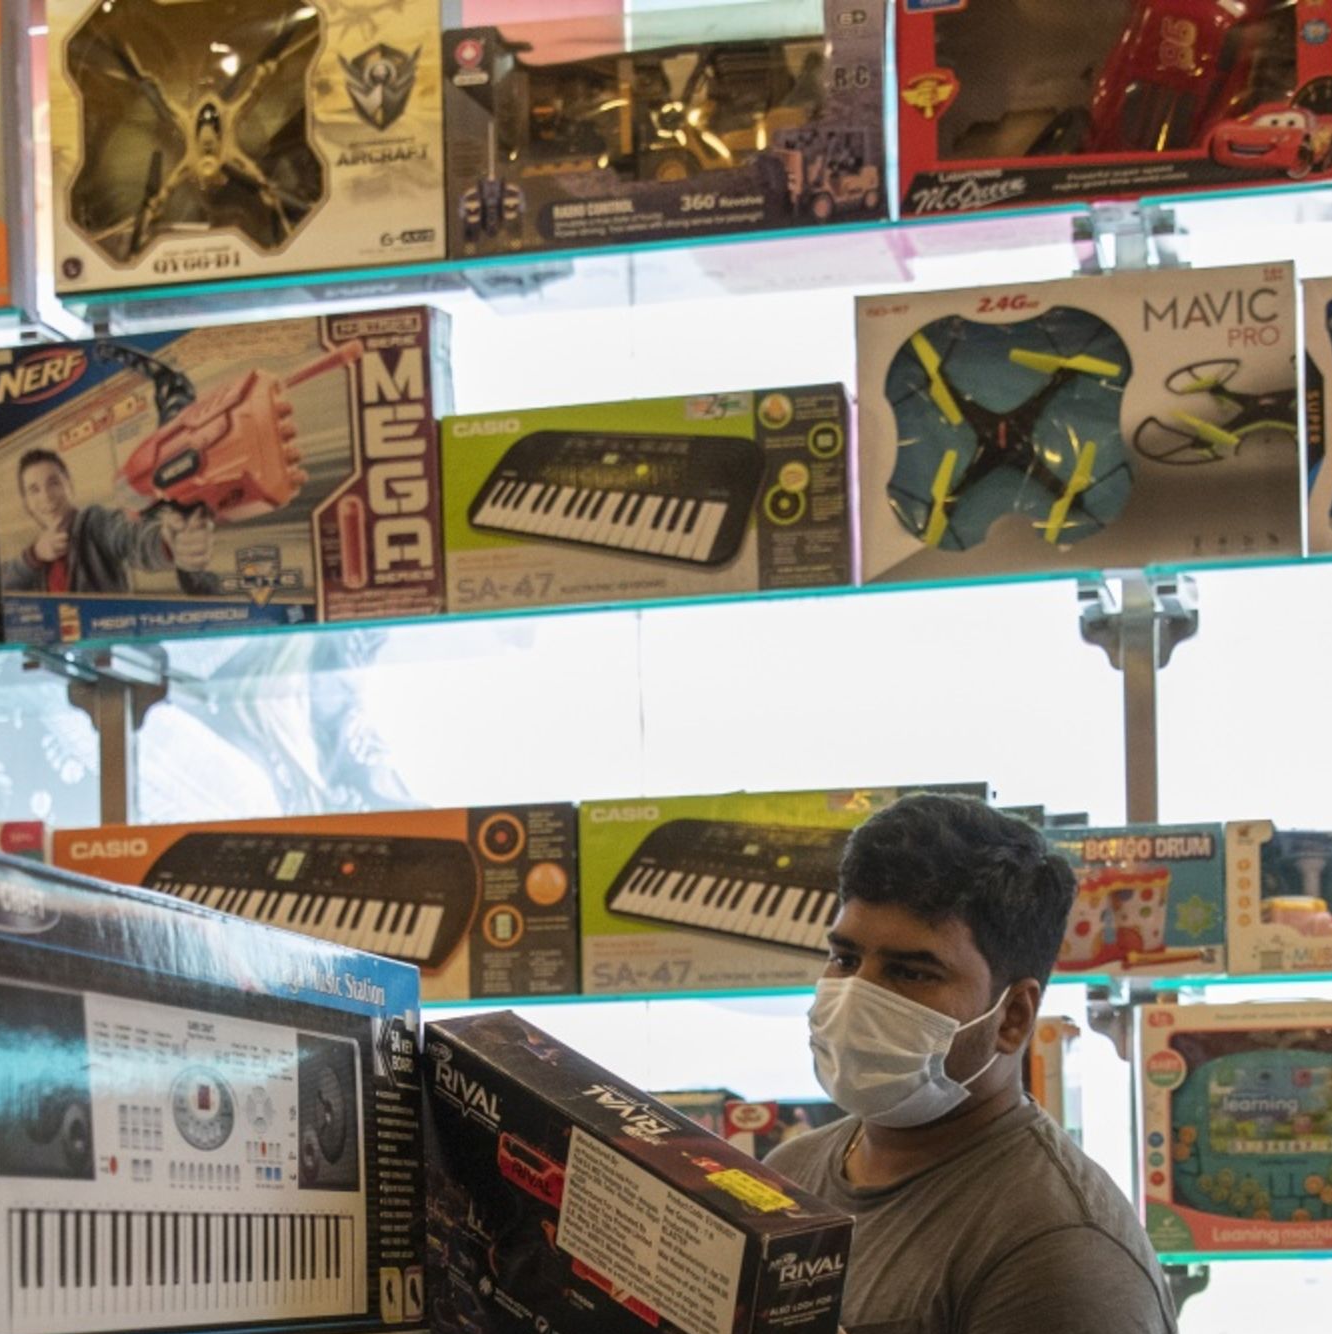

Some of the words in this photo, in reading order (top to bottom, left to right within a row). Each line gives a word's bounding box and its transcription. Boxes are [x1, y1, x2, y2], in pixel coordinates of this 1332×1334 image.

[913, 178, 1027, 214] McQueen
[1143, 288, 1279, 331] MAVIC
[1227, 325, 1281, 348] PRO
[452, 419, 520, 437] CASIO
[457, 572, 555, 603] SA-47
[590, 806, 659, 824] CASIO
[71, 839, 148, 861] CASIO
[1155, 834, 1212, 858] DRUM
[592, 961, 692, 987] SA-47
[345, 973, 385, 1006] Station
[435, 1062, 502, 1122] RIVAL
[1223, 1098, 1299, 1113] learning
[581, 1084, 672, 1136] RIVAL
[511, 1159, 553, 1199] RIVAL
[779, 1253, 845, 1283] RIVAL
